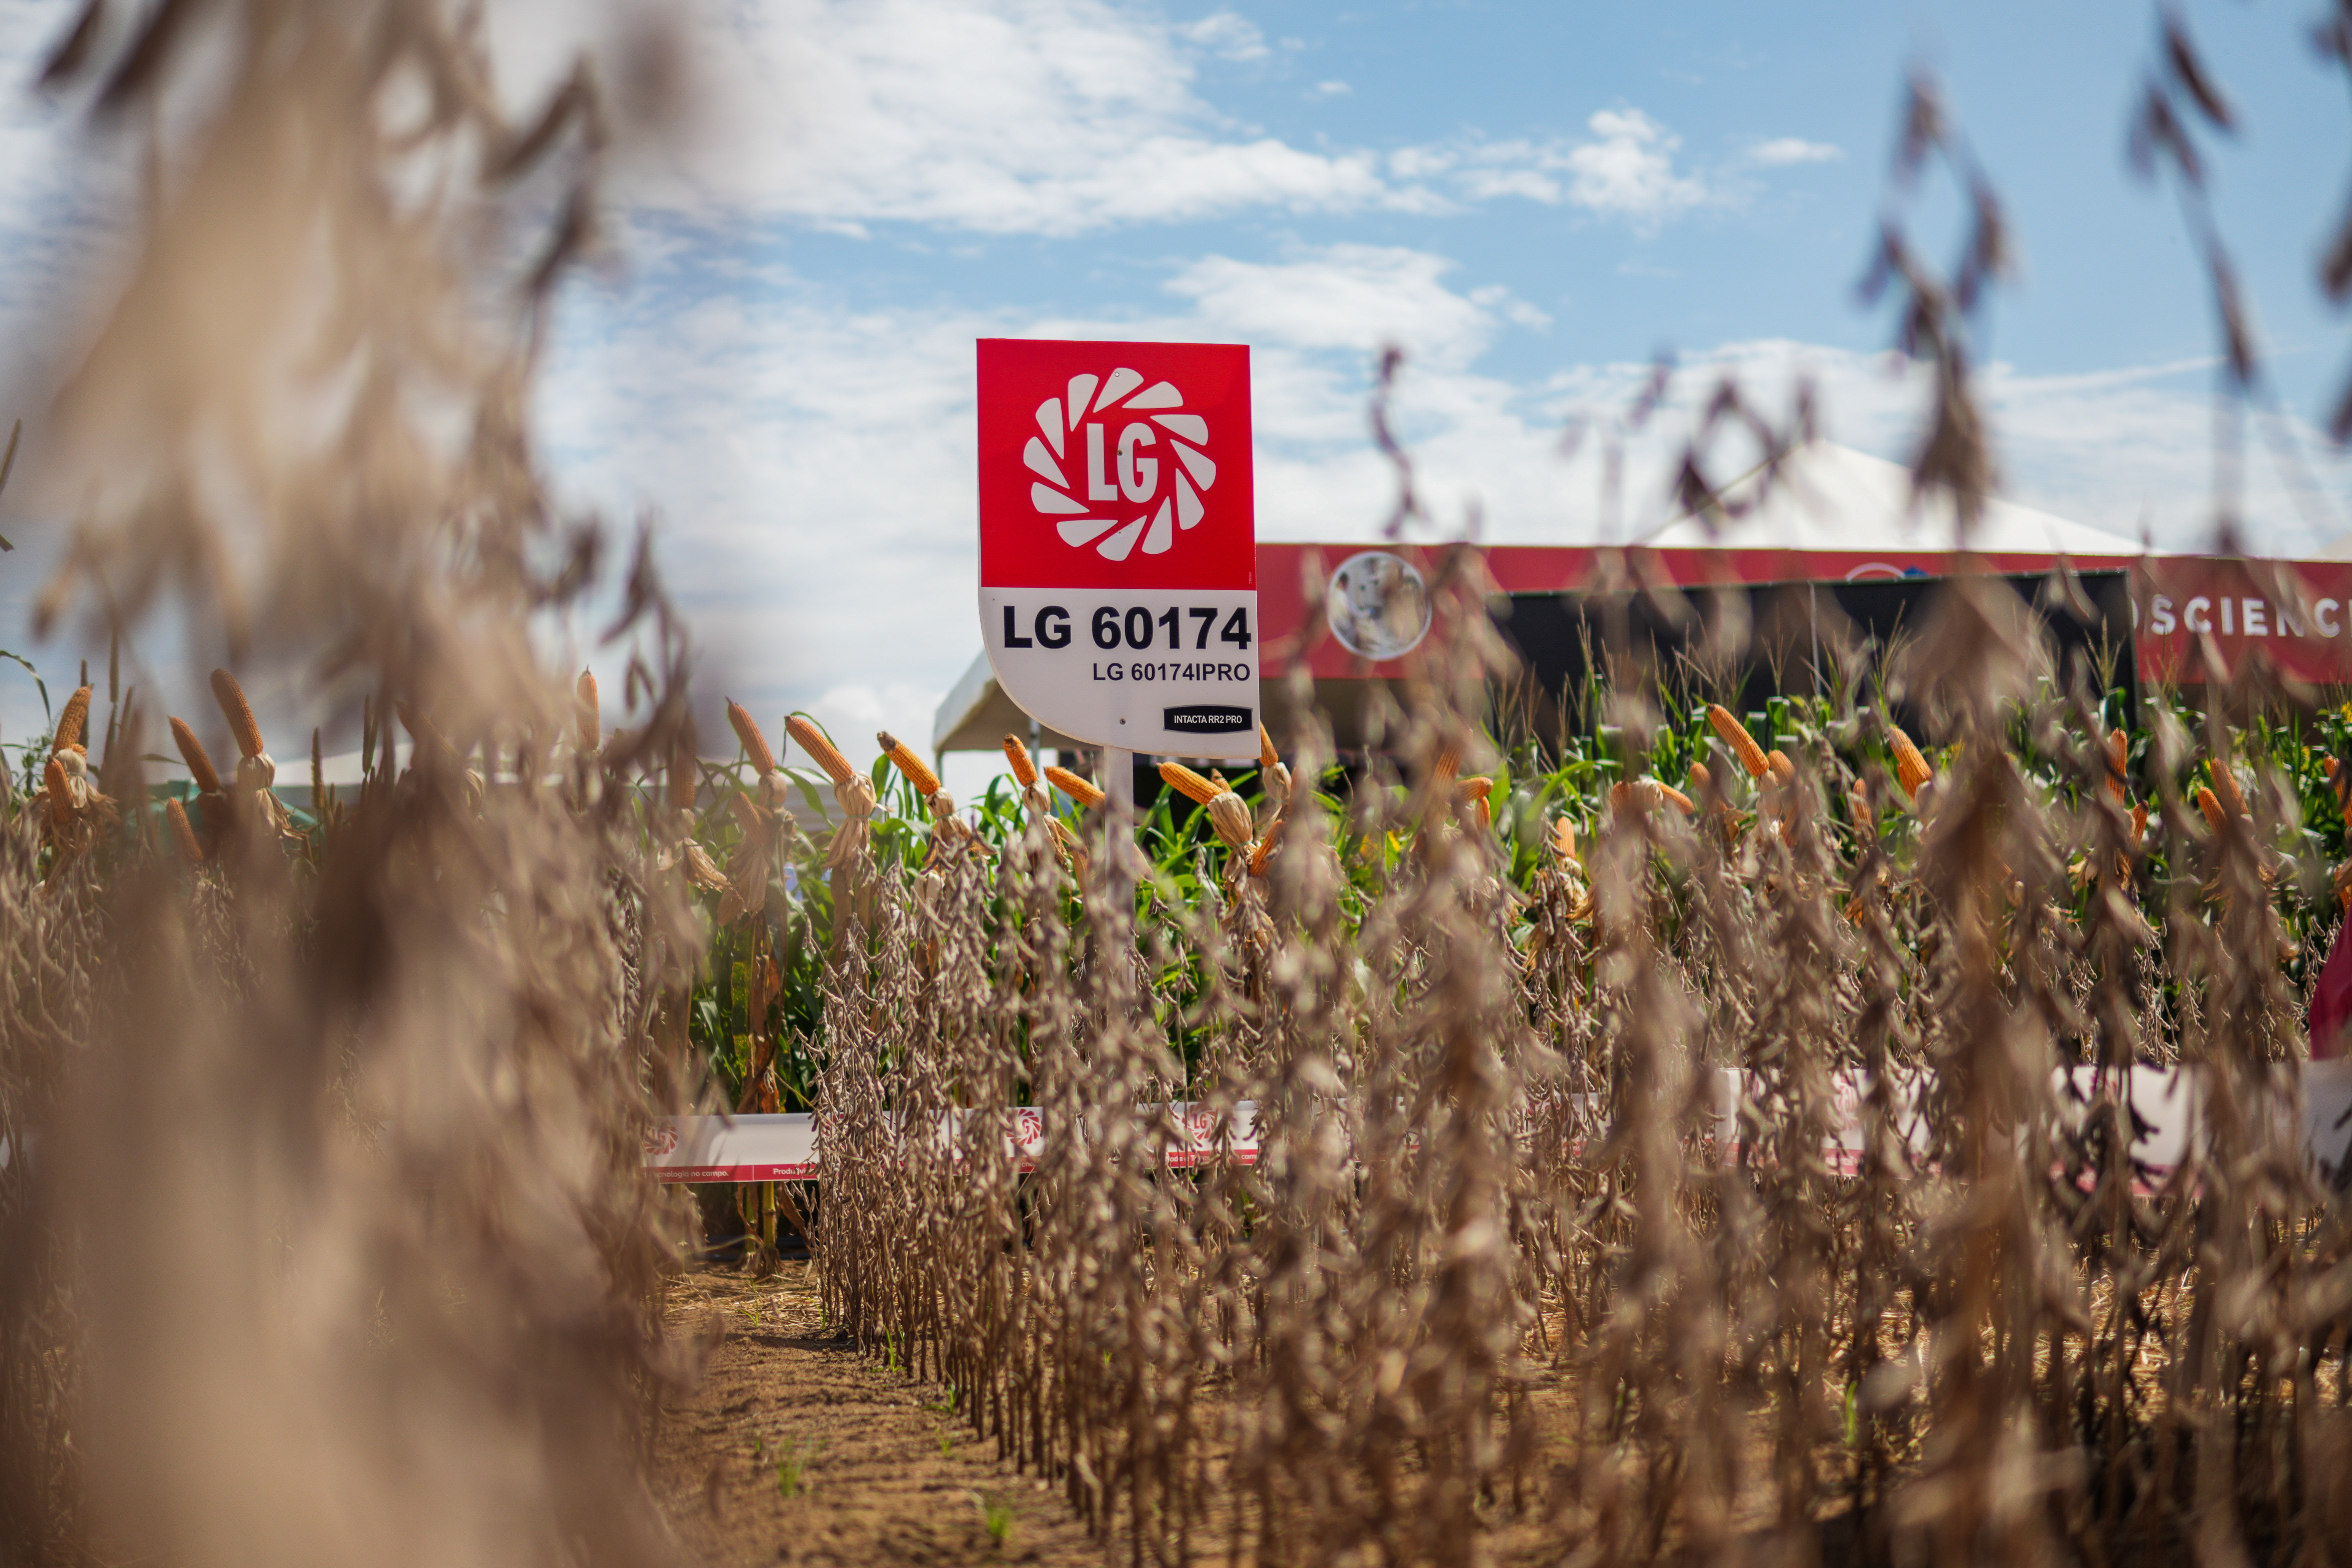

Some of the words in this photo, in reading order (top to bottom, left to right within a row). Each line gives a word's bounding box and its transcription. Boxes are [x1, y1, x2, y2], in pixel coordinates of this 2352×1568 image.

[1087, 422, 1158, 503] LG
[1004, 605, 1072, 649] LG
[1092, 605, 1252, 650] 60174
[2131, 594, 2352, 638] SCIENC
[1093, 662, 1124, 681] LG
[1131, 662, 1250, 682] 60174IPRO
[1174, 715, 1207, 724] INTACTA
[1208, 715, 1224, 724] RR2
[1226, 715, 1242, 724] PRO
